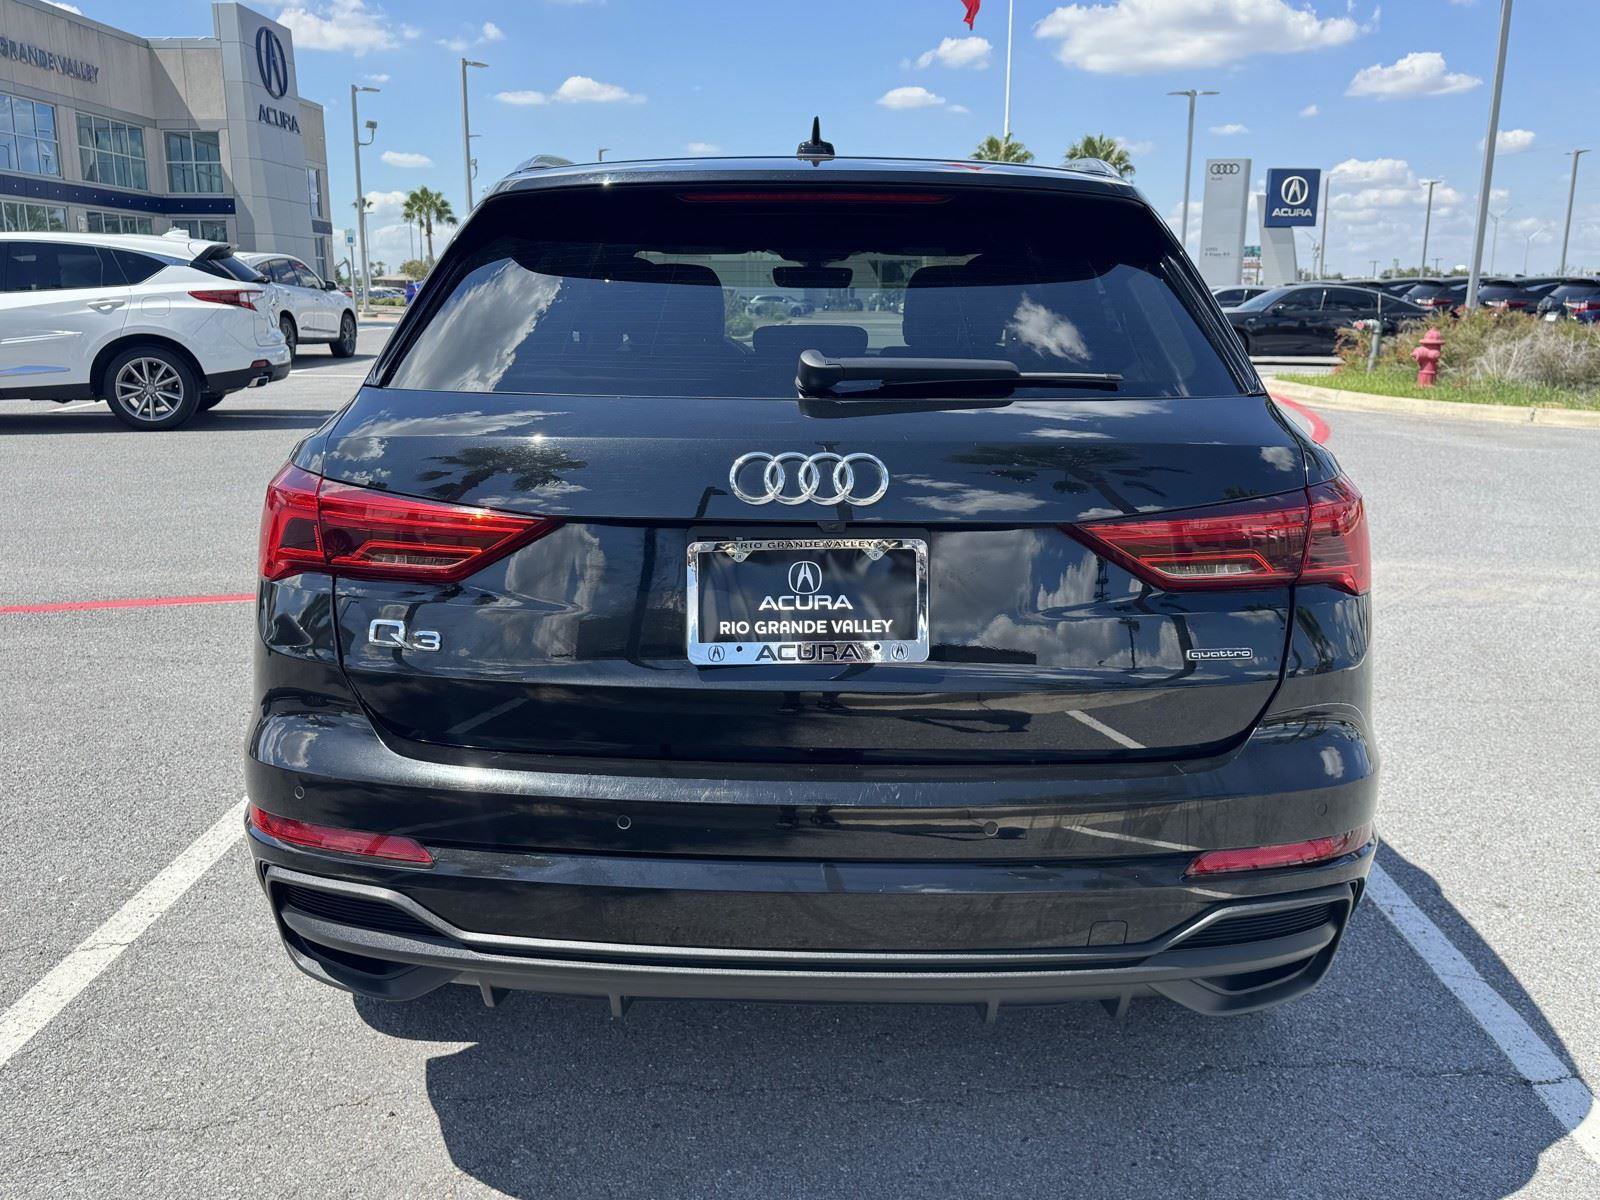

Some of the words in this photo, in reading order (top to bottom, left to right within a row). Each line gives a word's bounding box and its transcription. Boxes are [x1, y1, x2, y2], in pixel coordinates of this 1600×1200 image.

[0, 36, 55, 71] GRANDE
[53, 53, 99, 84] VALLEY
[259, 103, 300, 135] ACURA
[1271, 207, 1313, 217] ACURA
[767, 540, 822, 549] GRANDE
[825, 539, 874, 548] VALLEY
[758, 594, 853, 611] ACURA
[719, 620, 750, 635] RIO
[754, 619, 828, 634] GRANDE
[834, 618, 894, 633] VALLEY
[368, 619, 441, 652] Q3
[754, 643, 862, 662] ACURA
[1191, 650, 1251, 659] quattro
